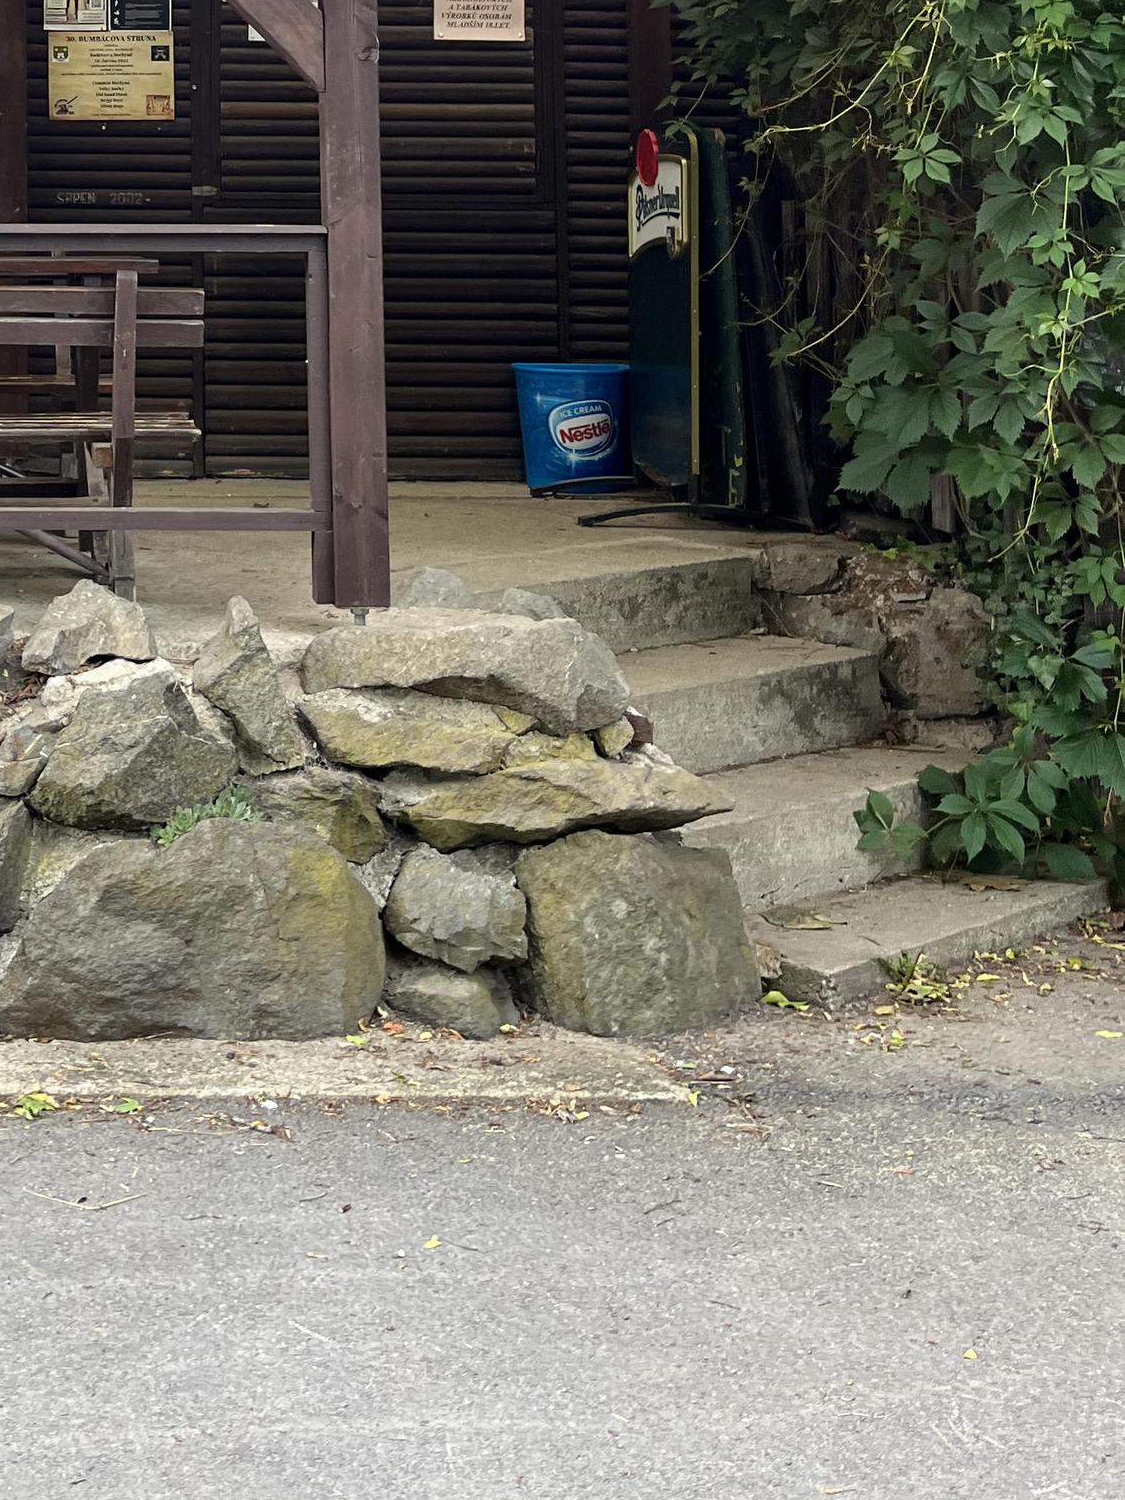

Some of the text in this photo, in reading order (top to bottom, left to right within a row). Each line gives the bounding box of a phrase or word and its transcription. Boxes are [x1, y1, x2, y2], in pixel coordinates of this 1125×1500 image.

[456, 3, 508, 11] TABÁKOVÝCH
[441, 11, 513, 20] VÝROBKŮ OSOBÁM
[446, 20, 483, 29] MLADŠÍM
[559, 404, 603, 419] ICE CREAM
